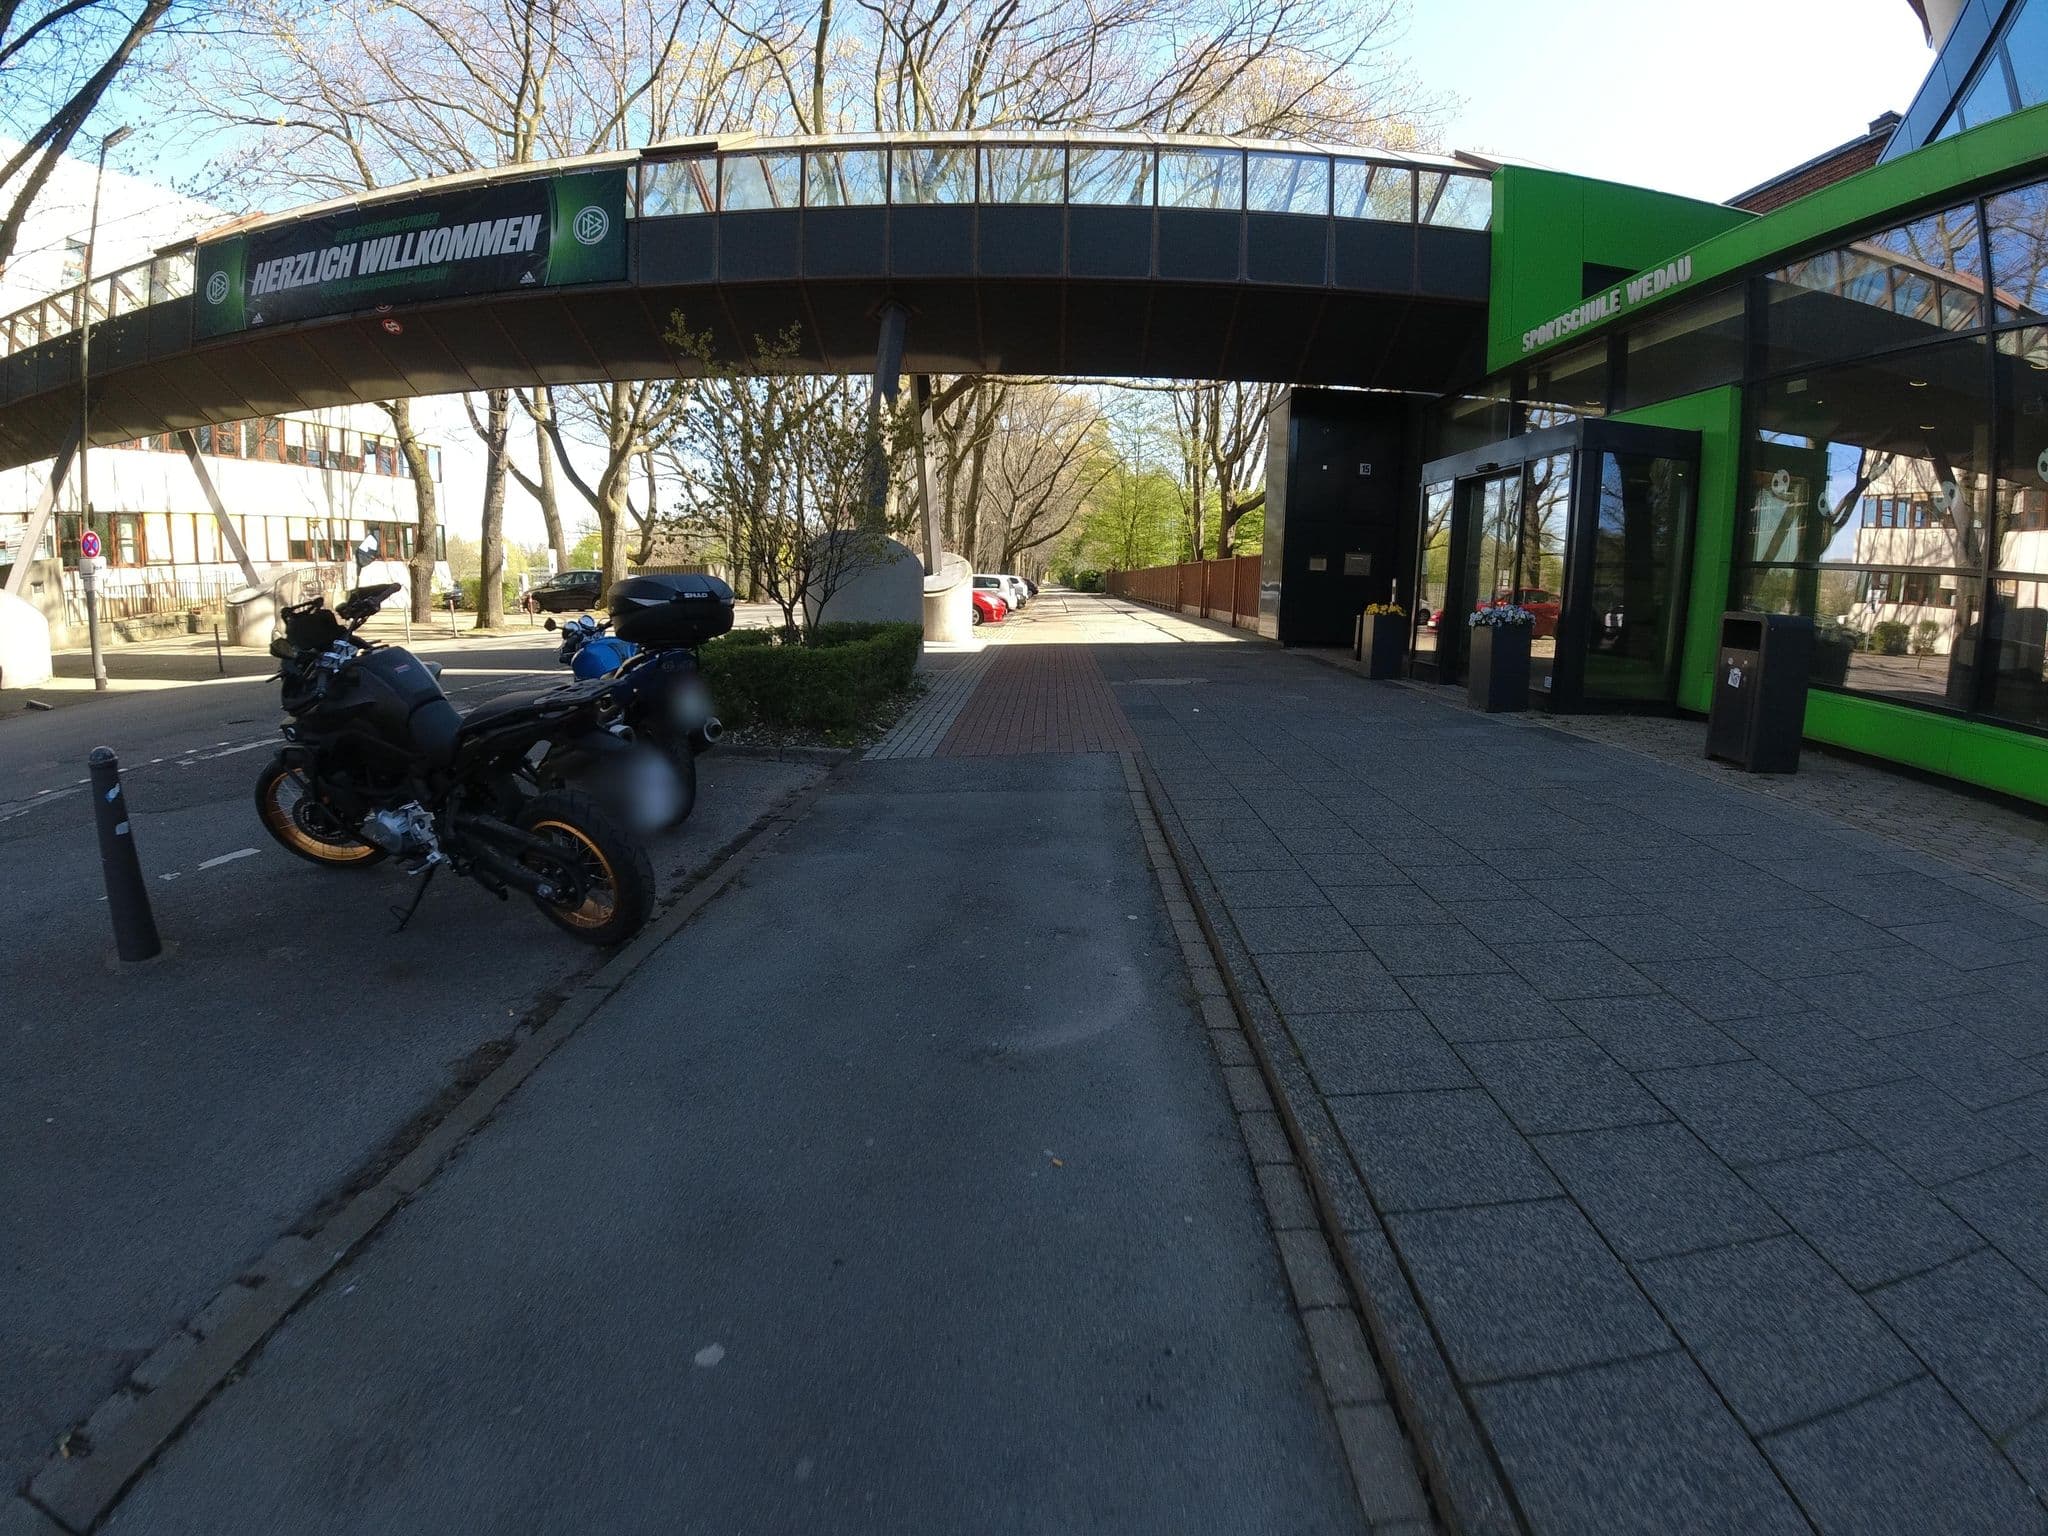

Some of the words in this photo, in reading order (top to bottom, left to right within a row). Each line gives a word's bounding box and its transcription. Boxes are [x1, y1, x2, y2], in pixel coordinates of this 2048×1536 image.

[251, 242, 358, 296] HERZLICH
[358, 214, 542, 275] WILLKOMMEN
[1522, 288, 1621, 353] SPORTSCHULE
[1626, 255, 1692, 305] WEDAU
[1361, 465, 1370, 474] 15
